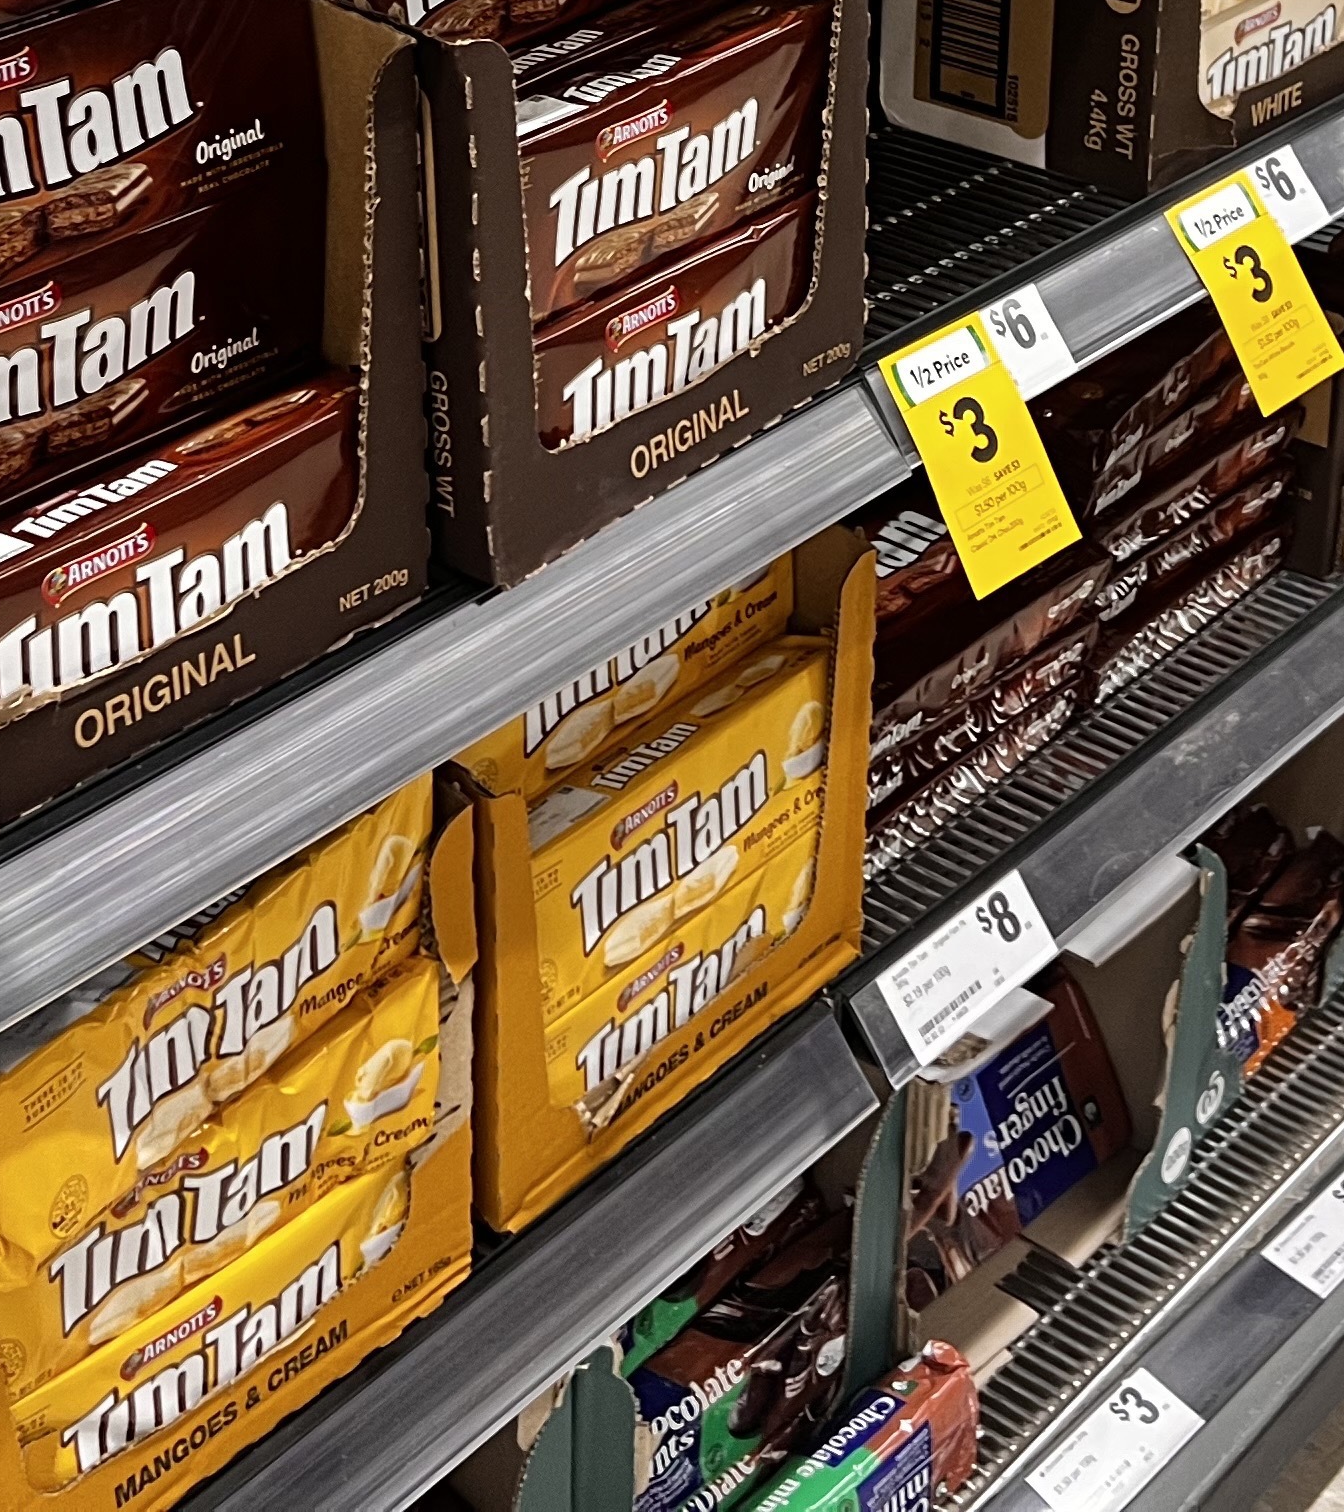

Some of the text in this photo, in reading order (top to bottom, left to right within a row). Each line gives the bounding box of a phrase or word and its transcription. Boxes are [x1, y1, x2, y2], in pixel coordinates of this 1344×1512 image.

[1206, 3, 1338, 103] TimTam
[612, 104, 670, 147] ARNOTT'S
[1084, 88, 1110, 152] 4.4Kg
[1114, 31, 1140, 162] GROSS WT
[1250, 81, 1304, 128] WHITE
[195, 118, 265, 166] Original
[550, 96, 761, 268] TimTam
[1255, 156, 1295, 202] $6
[1194, 203, 1246, 238] 1/2 Price
[1222, 244, 1273, 305] $3
[621, 294, 677, 333] ARNOTT'S
[989, 298, 1038, 350] $6
[190, 326, 261, 376] Original
[561, 277, 769, 447] TimTam
[802, 339, 853, 379] NET 200g
[910, 350, 972, 390] 1/2 Price
[429, 370, 456, 519] GROSS WT
[630, 388, 750, 479] ORIGINAL
[938, 396, 1000, 464] $3
[67, 531, 151, 587] ARNOTT'S
[337, 566, 409, 615] NET 200g
[74, 632, 257, 750] ORIGINAL
[570, 750, 770, 957] TimTam
[975, 890, 1022, 943] $8
[691, 980, 771, 1054] & CREAM
[372, 1114, 430, 1150] Cream
[982, 1075, 1068, 1160] fingers
[966, 1117, 1085, 1221] Chocolate
[63, 1238, 342, 1476] TimTam
[114, 1318, 351, 1508] MANGOES & CREAM
[1108, 1386, 1161, 1426] $3
